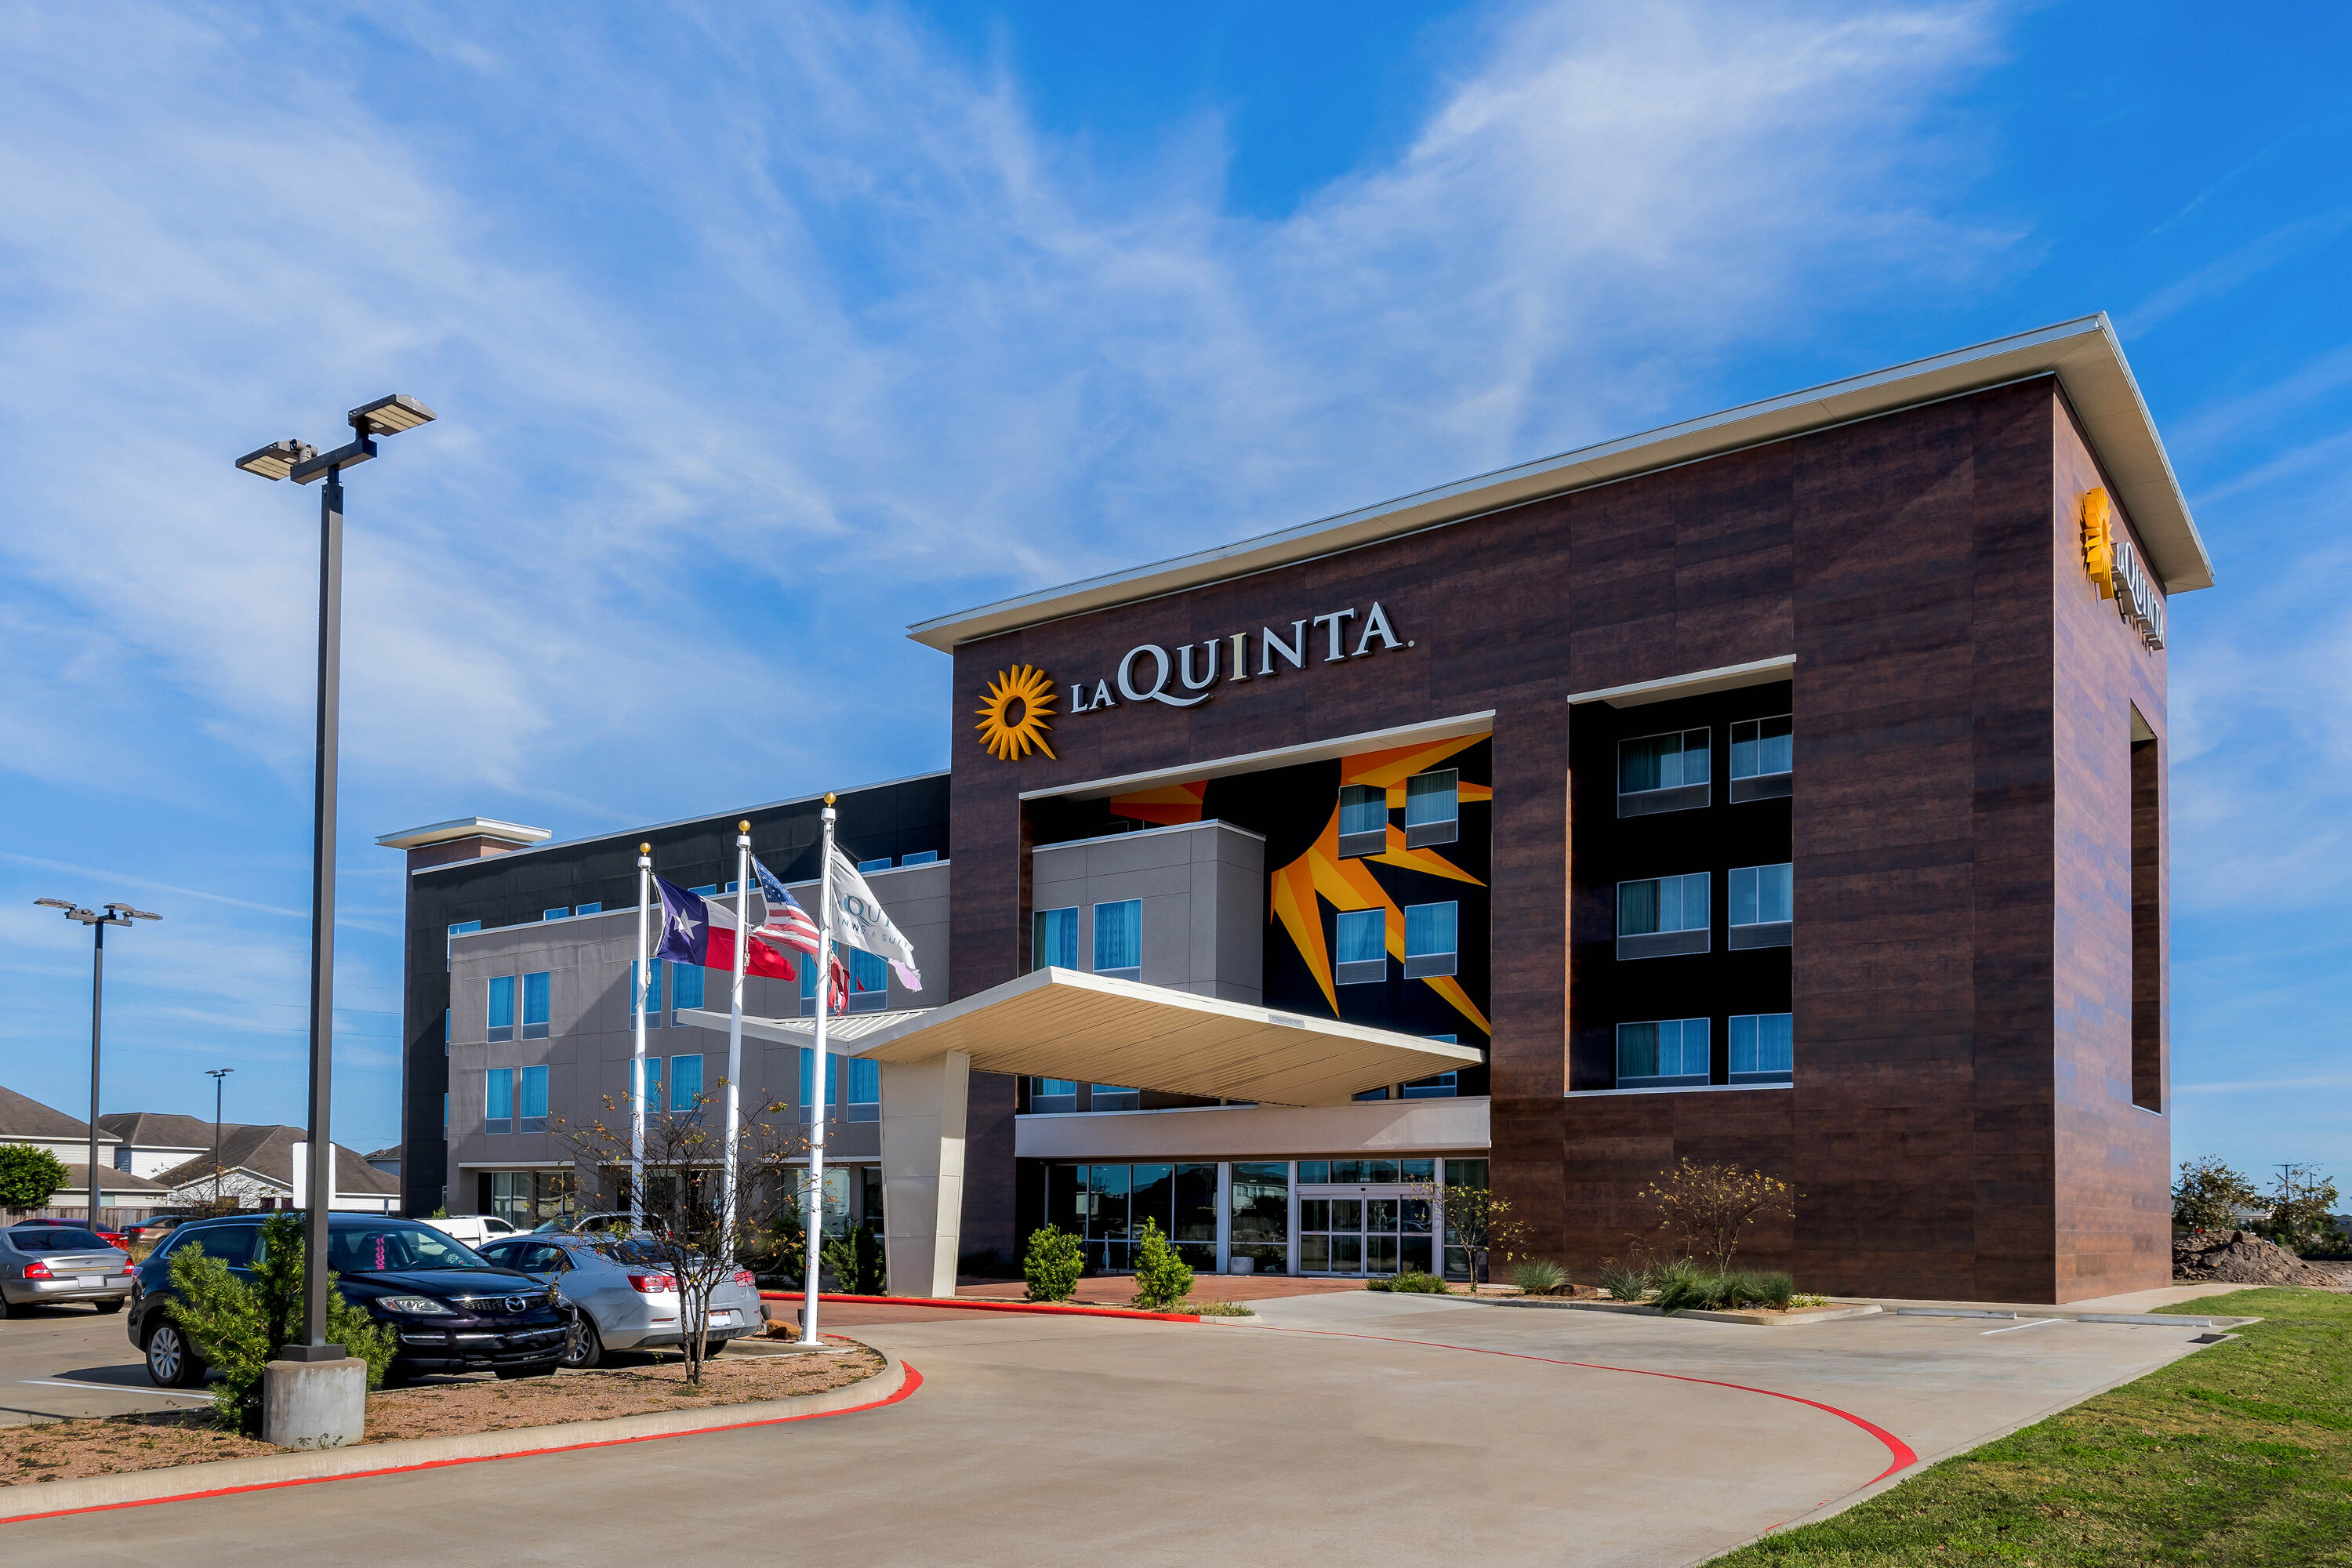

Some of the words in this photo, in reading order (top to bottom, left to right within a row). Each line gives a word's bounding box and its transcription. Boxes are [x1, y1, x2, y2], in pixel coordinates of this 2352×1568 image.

[1070, 678, 1116, 713] LA
[844, 895, 891, 928] QUI
[837, 917, 866, 935] INNS
[881, 934, 909, 948] SUIT
